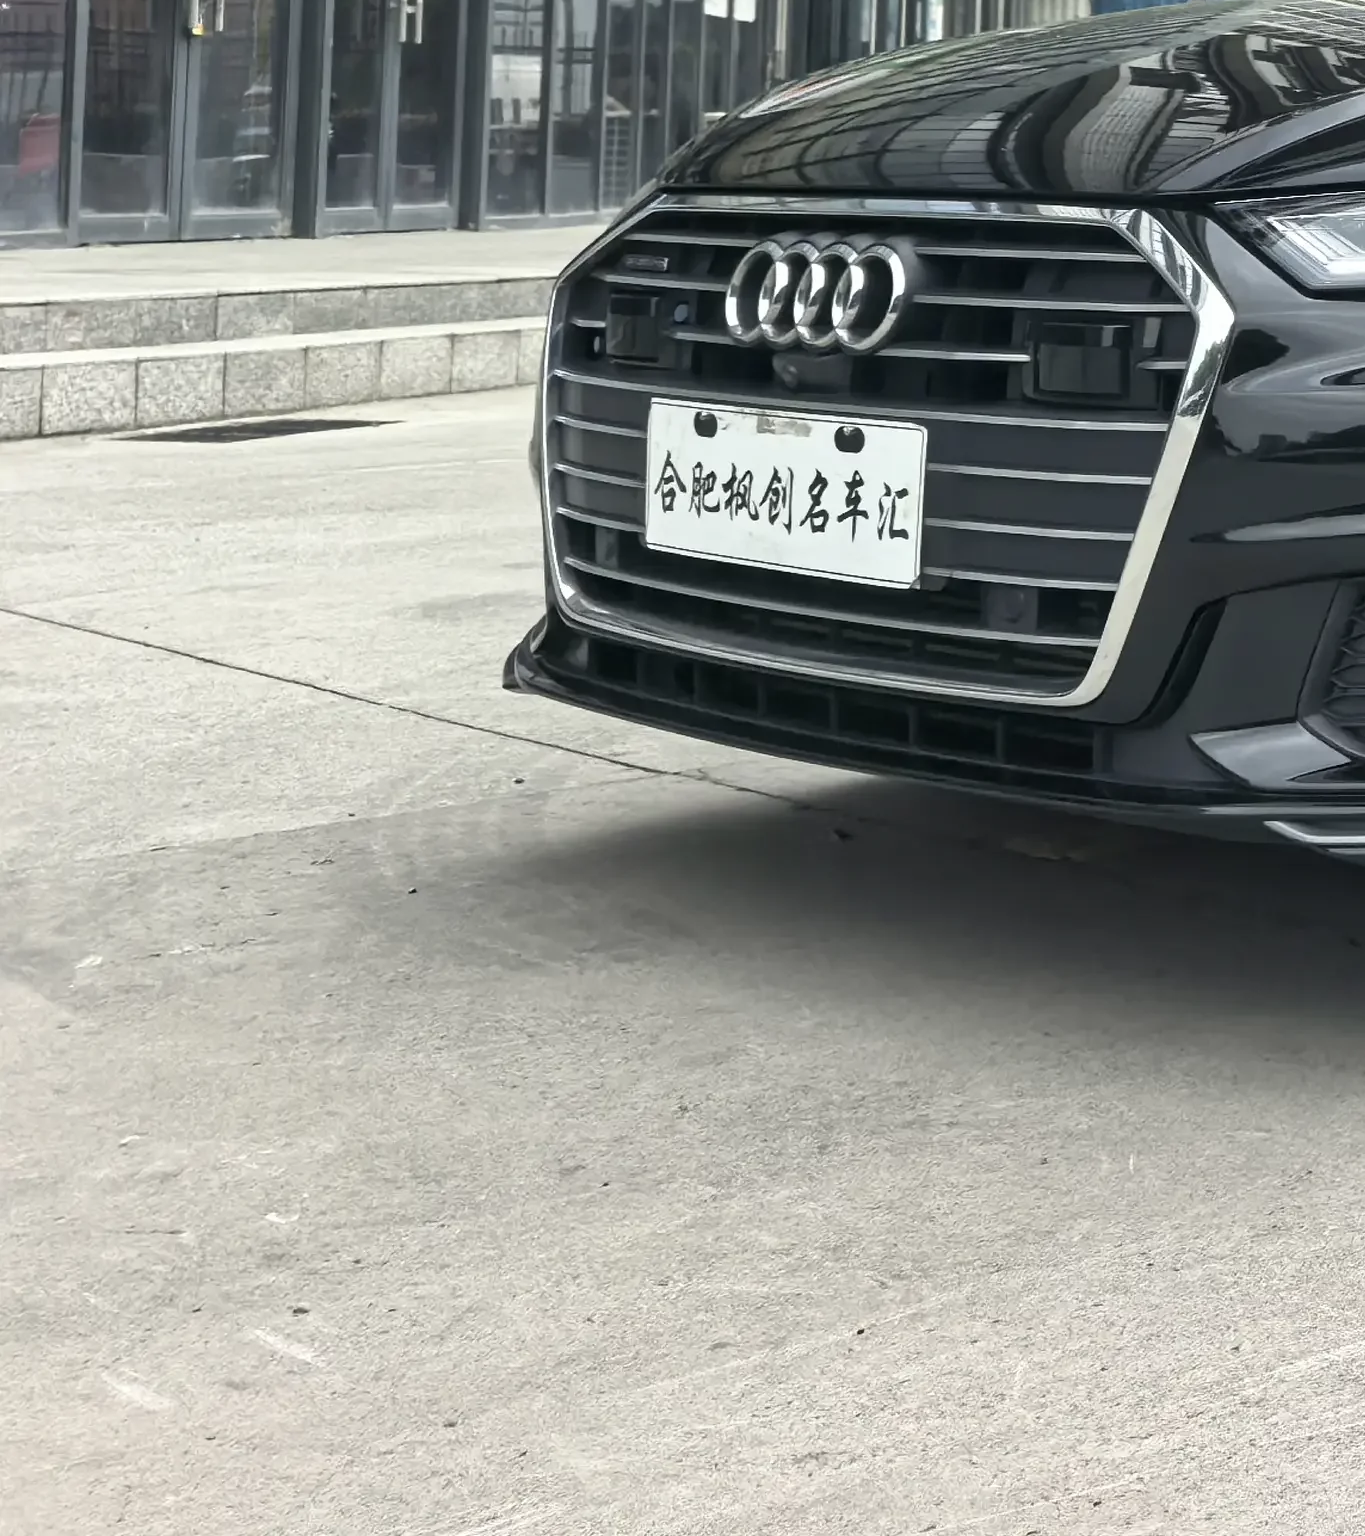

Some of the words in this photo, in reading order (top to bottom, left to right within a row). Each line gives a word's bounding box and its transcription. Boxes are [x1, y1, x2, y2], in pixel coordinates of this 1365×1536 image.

[654, 450, 909, 542] 合肥枫创名车汇
